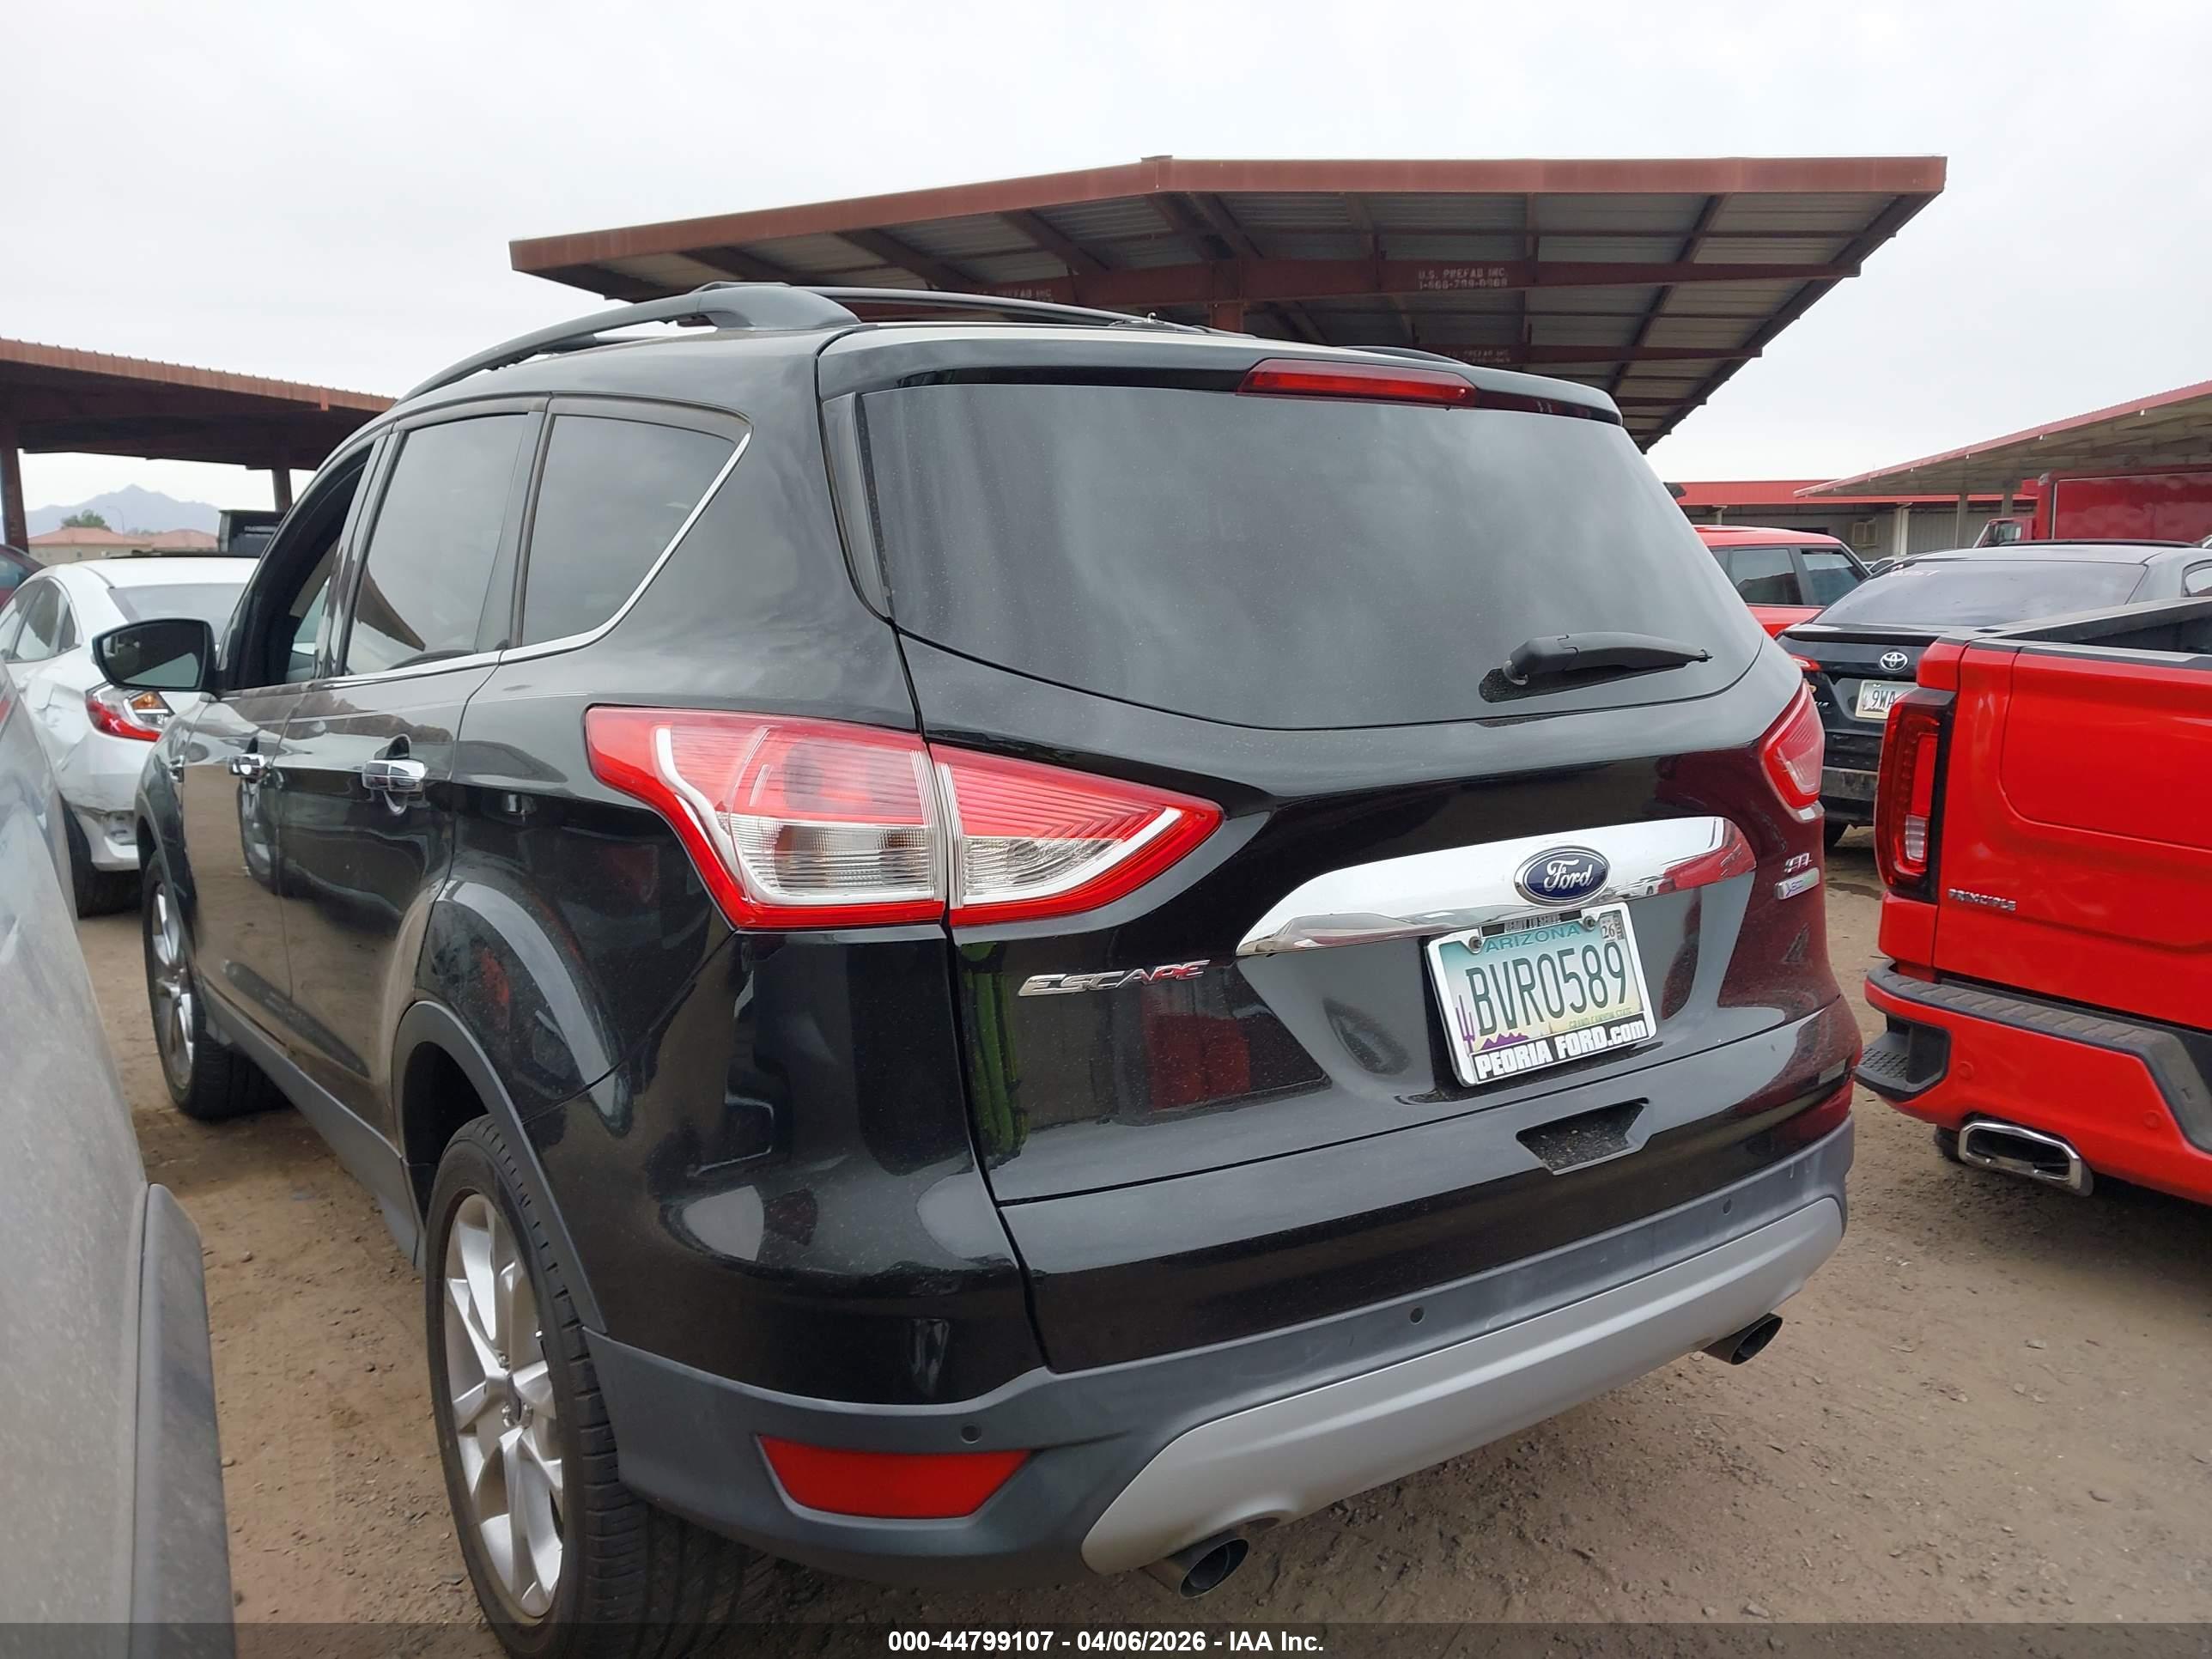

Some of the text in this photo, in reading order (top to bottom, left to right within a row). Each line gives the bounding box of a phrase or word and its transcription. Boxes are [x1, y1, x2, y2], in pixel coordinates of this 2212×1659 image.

[1543, 859, 1594, 892] Ford
[1485, 923, 1581, 954] ARIZONA
[1601, 922, 1615, 939] 26
[1018, 959, 1211, 997] ESCAPE
[1466, 941, 1626, 1036] BVR0589
[1474, 1018, 1647, 1080] PEORIA FORD.com
